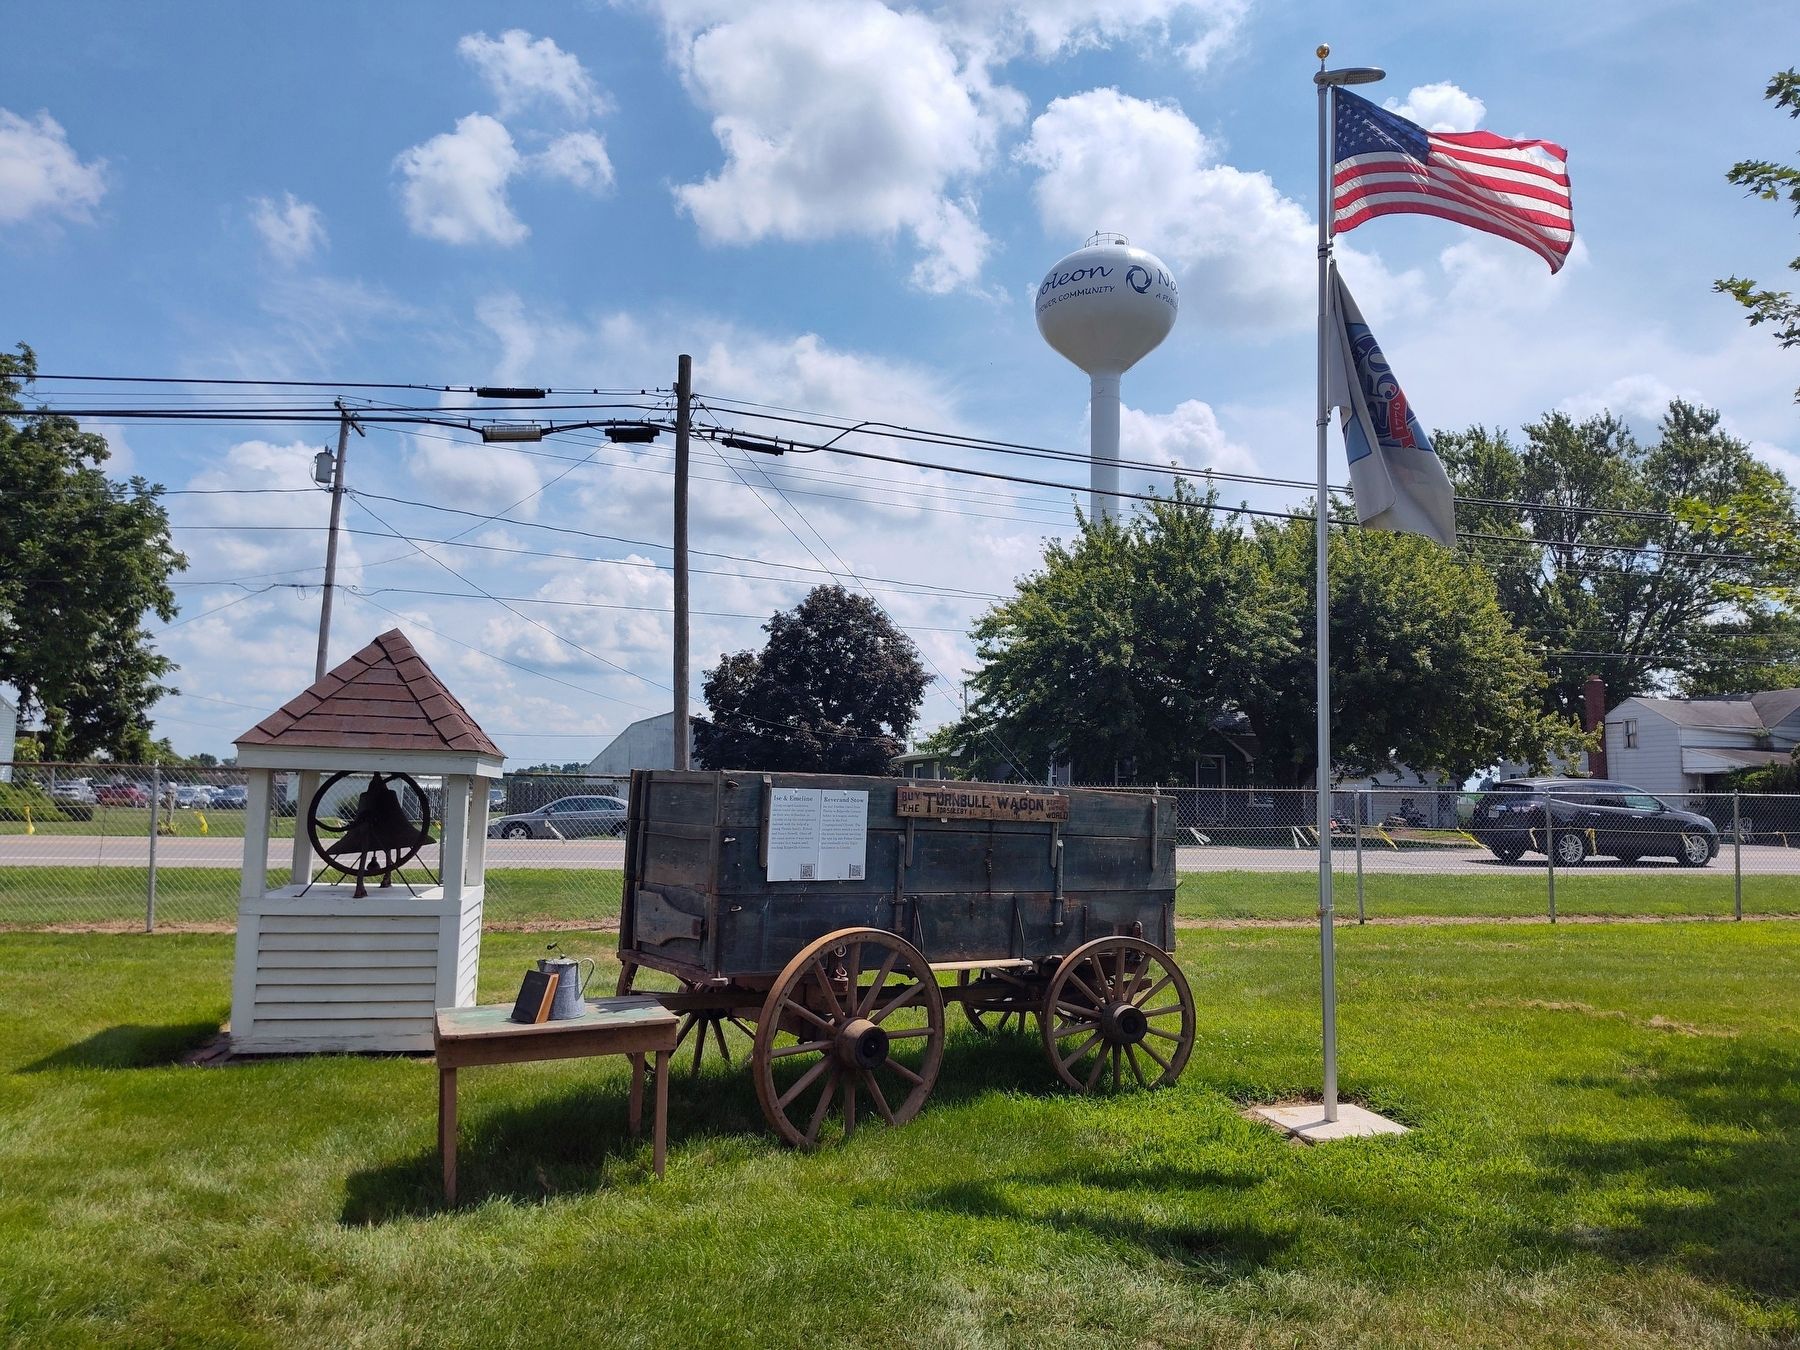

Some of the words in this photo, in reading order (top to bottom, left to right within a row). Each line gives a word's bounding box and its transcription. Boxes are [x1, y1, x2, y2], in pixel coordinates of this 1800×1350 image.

[1058, 285, 1116, 302] COMMUNITY
[1393, 403, 1404, 431] 1776
[902, 790, 920, 801] BUY
[902, 803, 920, 813] THE
[996, 795, 1044, 812] WAGON
[1045, 811, 1069, 820] WORLD
